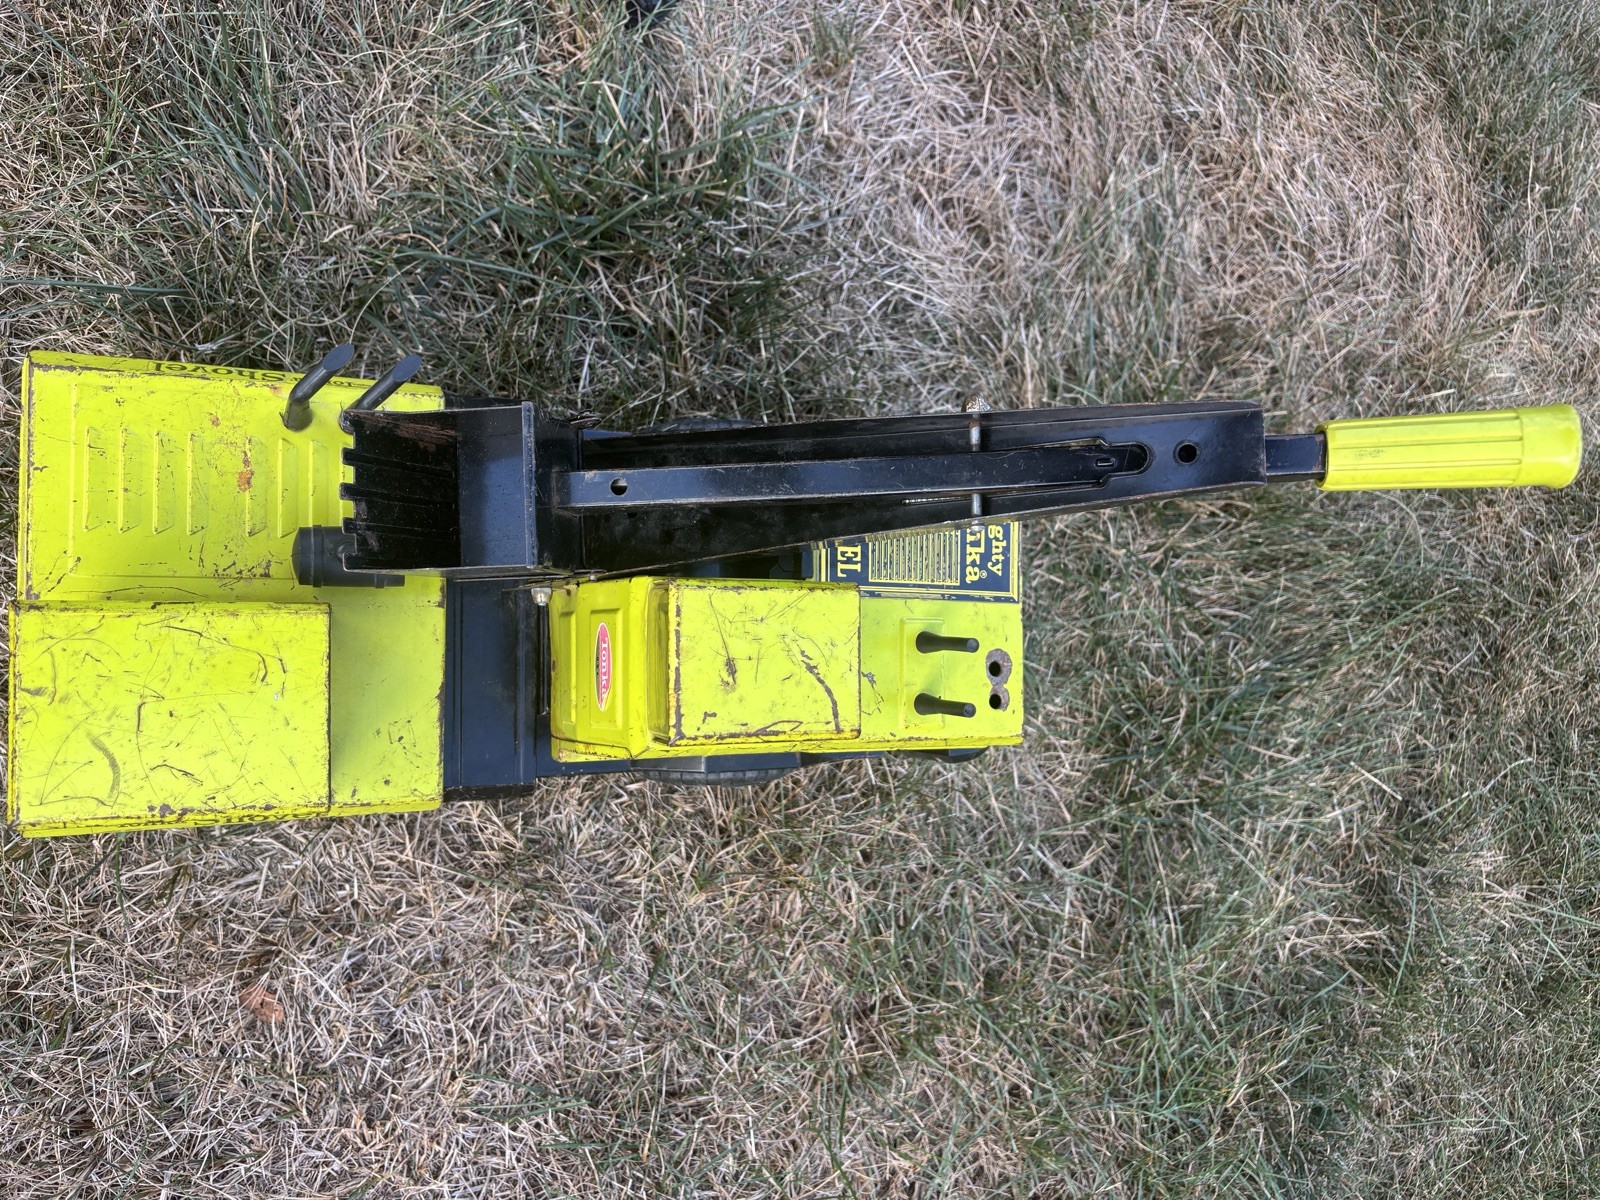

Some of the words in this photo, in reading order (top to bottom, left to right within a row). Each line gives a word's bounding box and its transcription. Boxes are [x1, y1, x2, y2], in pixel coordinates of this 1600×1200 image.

[152, 361, 286, 382] Shovel
[837, 545, 862, 578] EL
[965, 527, 986, 584] nka
[987, 524, 1007, 577] ghty
